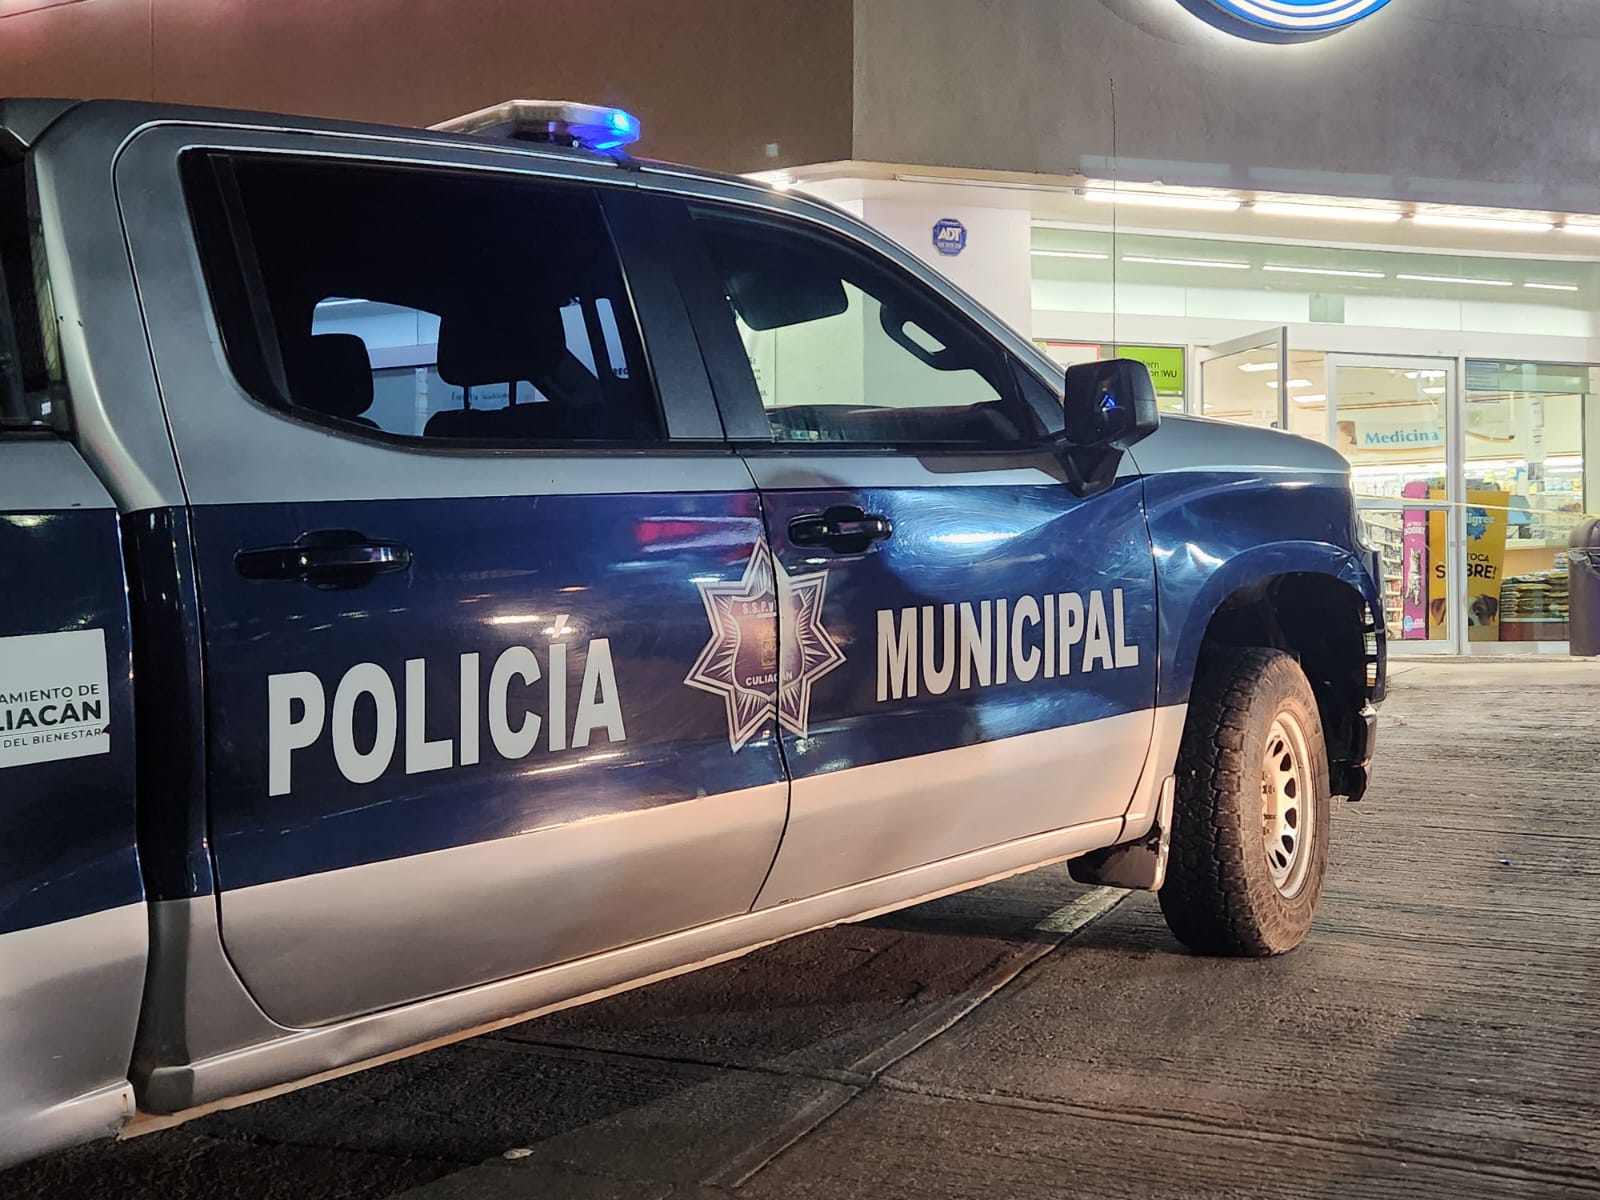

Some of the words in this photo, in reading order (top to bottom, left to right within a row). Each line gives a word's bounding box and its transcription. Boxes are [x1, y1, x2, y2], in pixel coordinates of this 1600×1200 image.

[938, 227, 961, 241] ADT
[1365, 429, 1439, 445] Medicina
[1435, 564, 1497, 580] SBRE!
[78, 683, 100, 697] DE
[267, 613, 627, 798] POLICÍA
[876, 587, 1140, 703] MUNICIPAL
[3, 738, 29, 748] DEL
[32, 728, 102, 745] BIENESTAR
